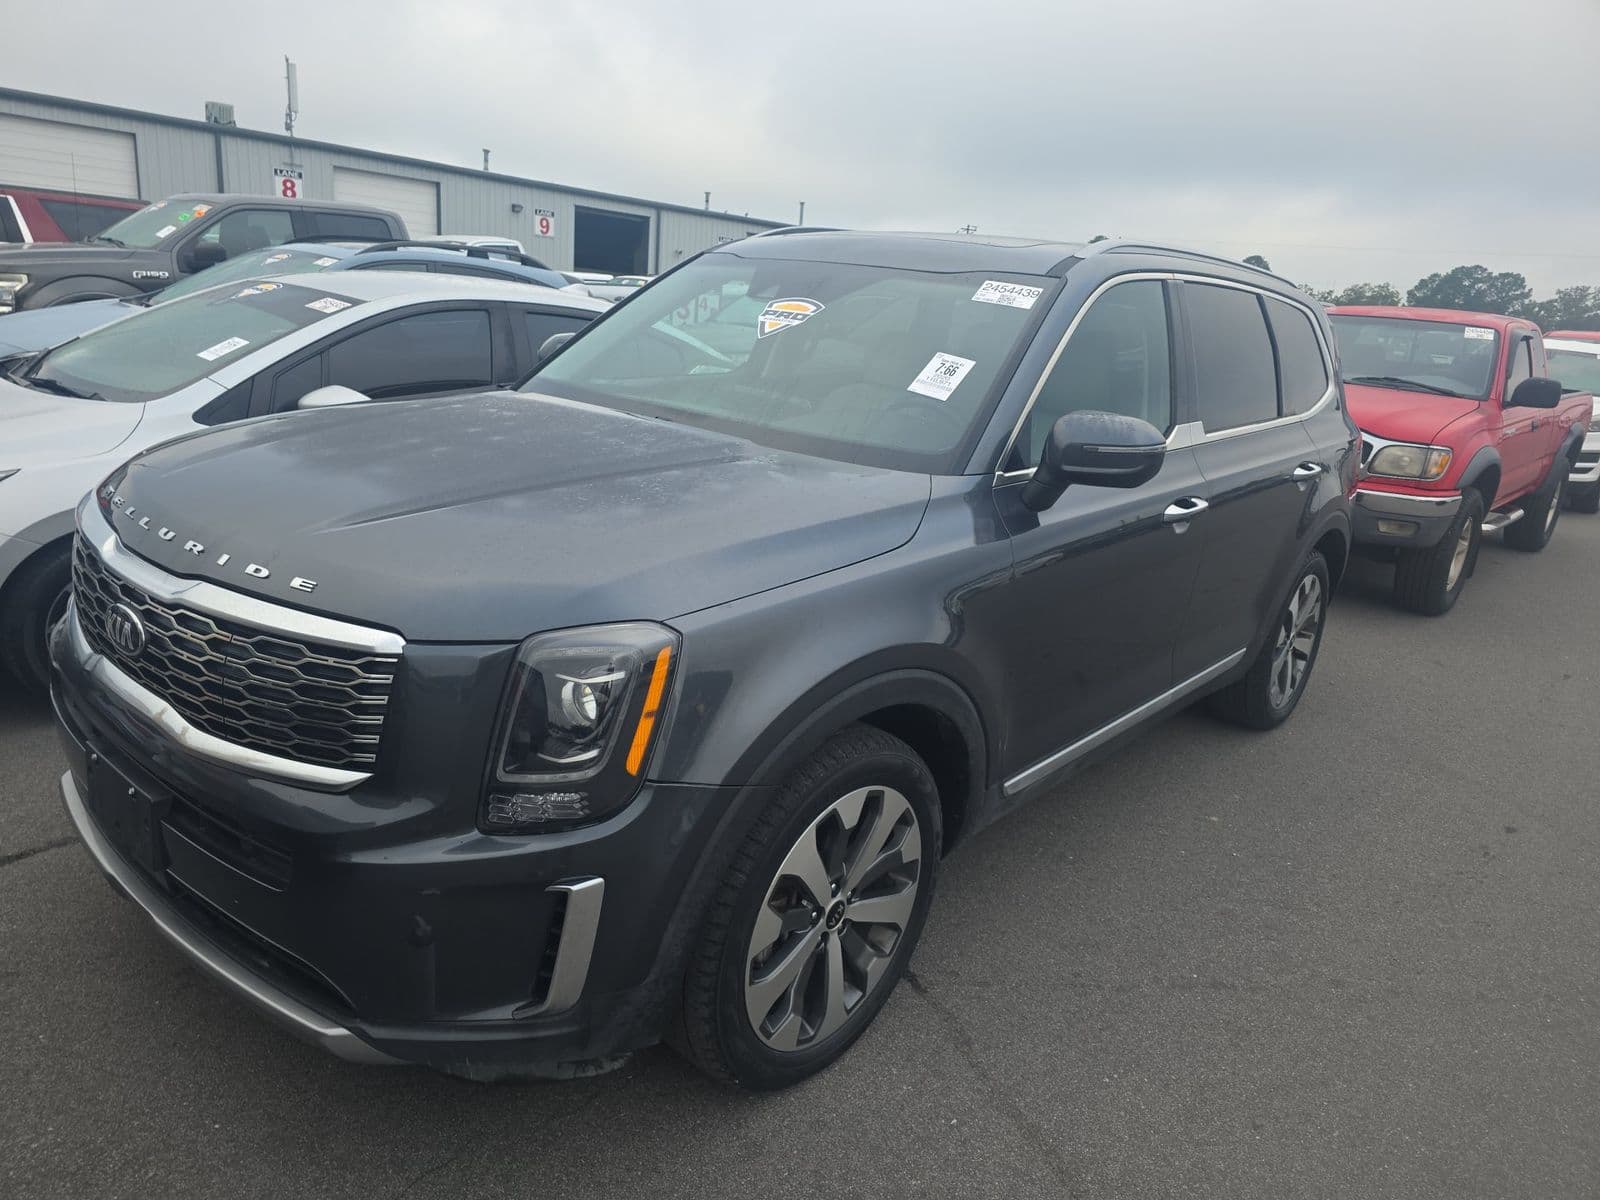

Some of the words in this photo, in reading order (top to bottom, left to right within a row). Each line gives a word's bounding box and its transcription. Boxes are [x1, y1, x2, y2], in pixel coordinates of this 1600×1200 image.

[277, 168, 298, 178] LANE
[282, 179, 297, 199] 8
[540, 217, 549, 235] 9
[982, 282, 1041, 299] 2454439
[935, 362, 960, 377] 7:66
[106, 608, 136, 651] KIA
